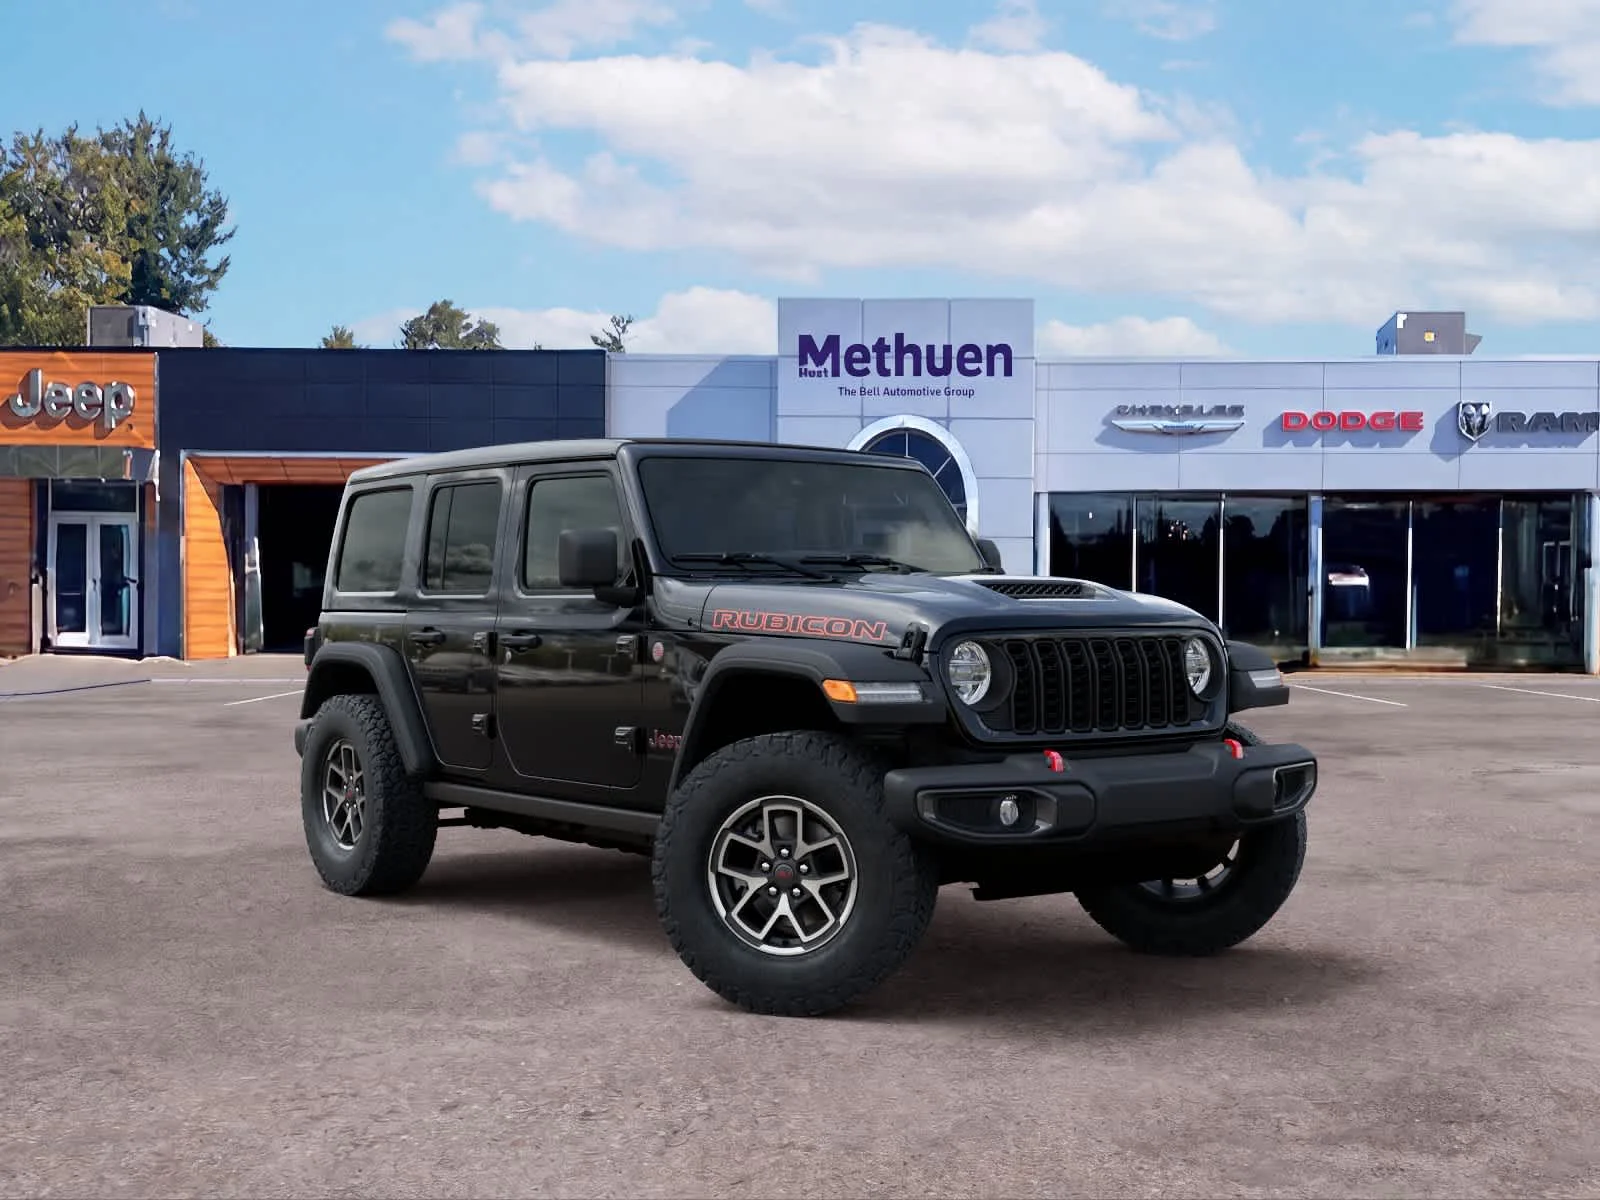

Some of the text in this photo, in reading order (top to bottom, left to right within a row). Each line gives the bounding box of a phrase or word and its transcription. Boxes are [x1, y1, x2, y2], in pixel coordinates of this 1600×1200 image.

[798, 333, 1013, 377] Methuen
[9, 368, 135, 428] Jeep
[838, 386, 975, 399] The Bell Automotive Group
[1282, 411, 1424, 432] DODGE
[1497, 411, 1600, 433] RAM
[712, 608, 888, 640] RUBICON
